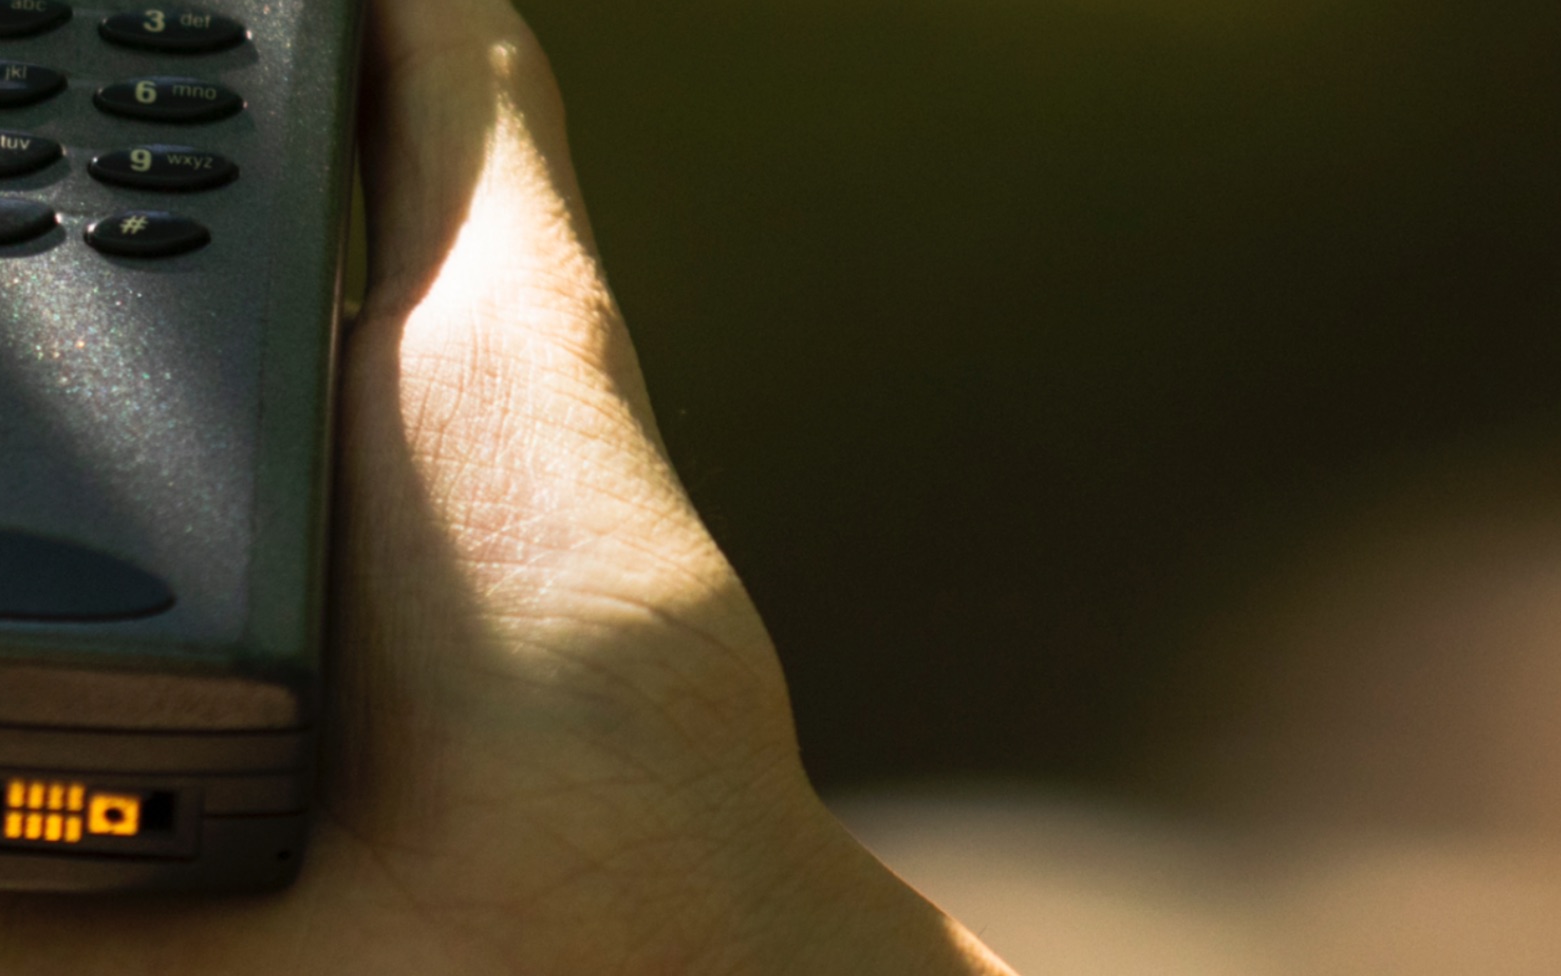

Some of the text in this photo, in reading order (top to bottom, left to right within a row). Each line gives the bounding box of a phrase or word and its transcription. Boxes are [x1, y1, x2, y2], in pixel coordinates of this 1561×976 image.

[143, 9, 212, 33] 3 def
[4, 64, 28, 81] jkl
[134, 79, 218, 104] 6 mno
[0, 134, 31, 150] tuv
[129, 148, 214, 173] 9 wxyz
[120, 215, 149, 235] #
